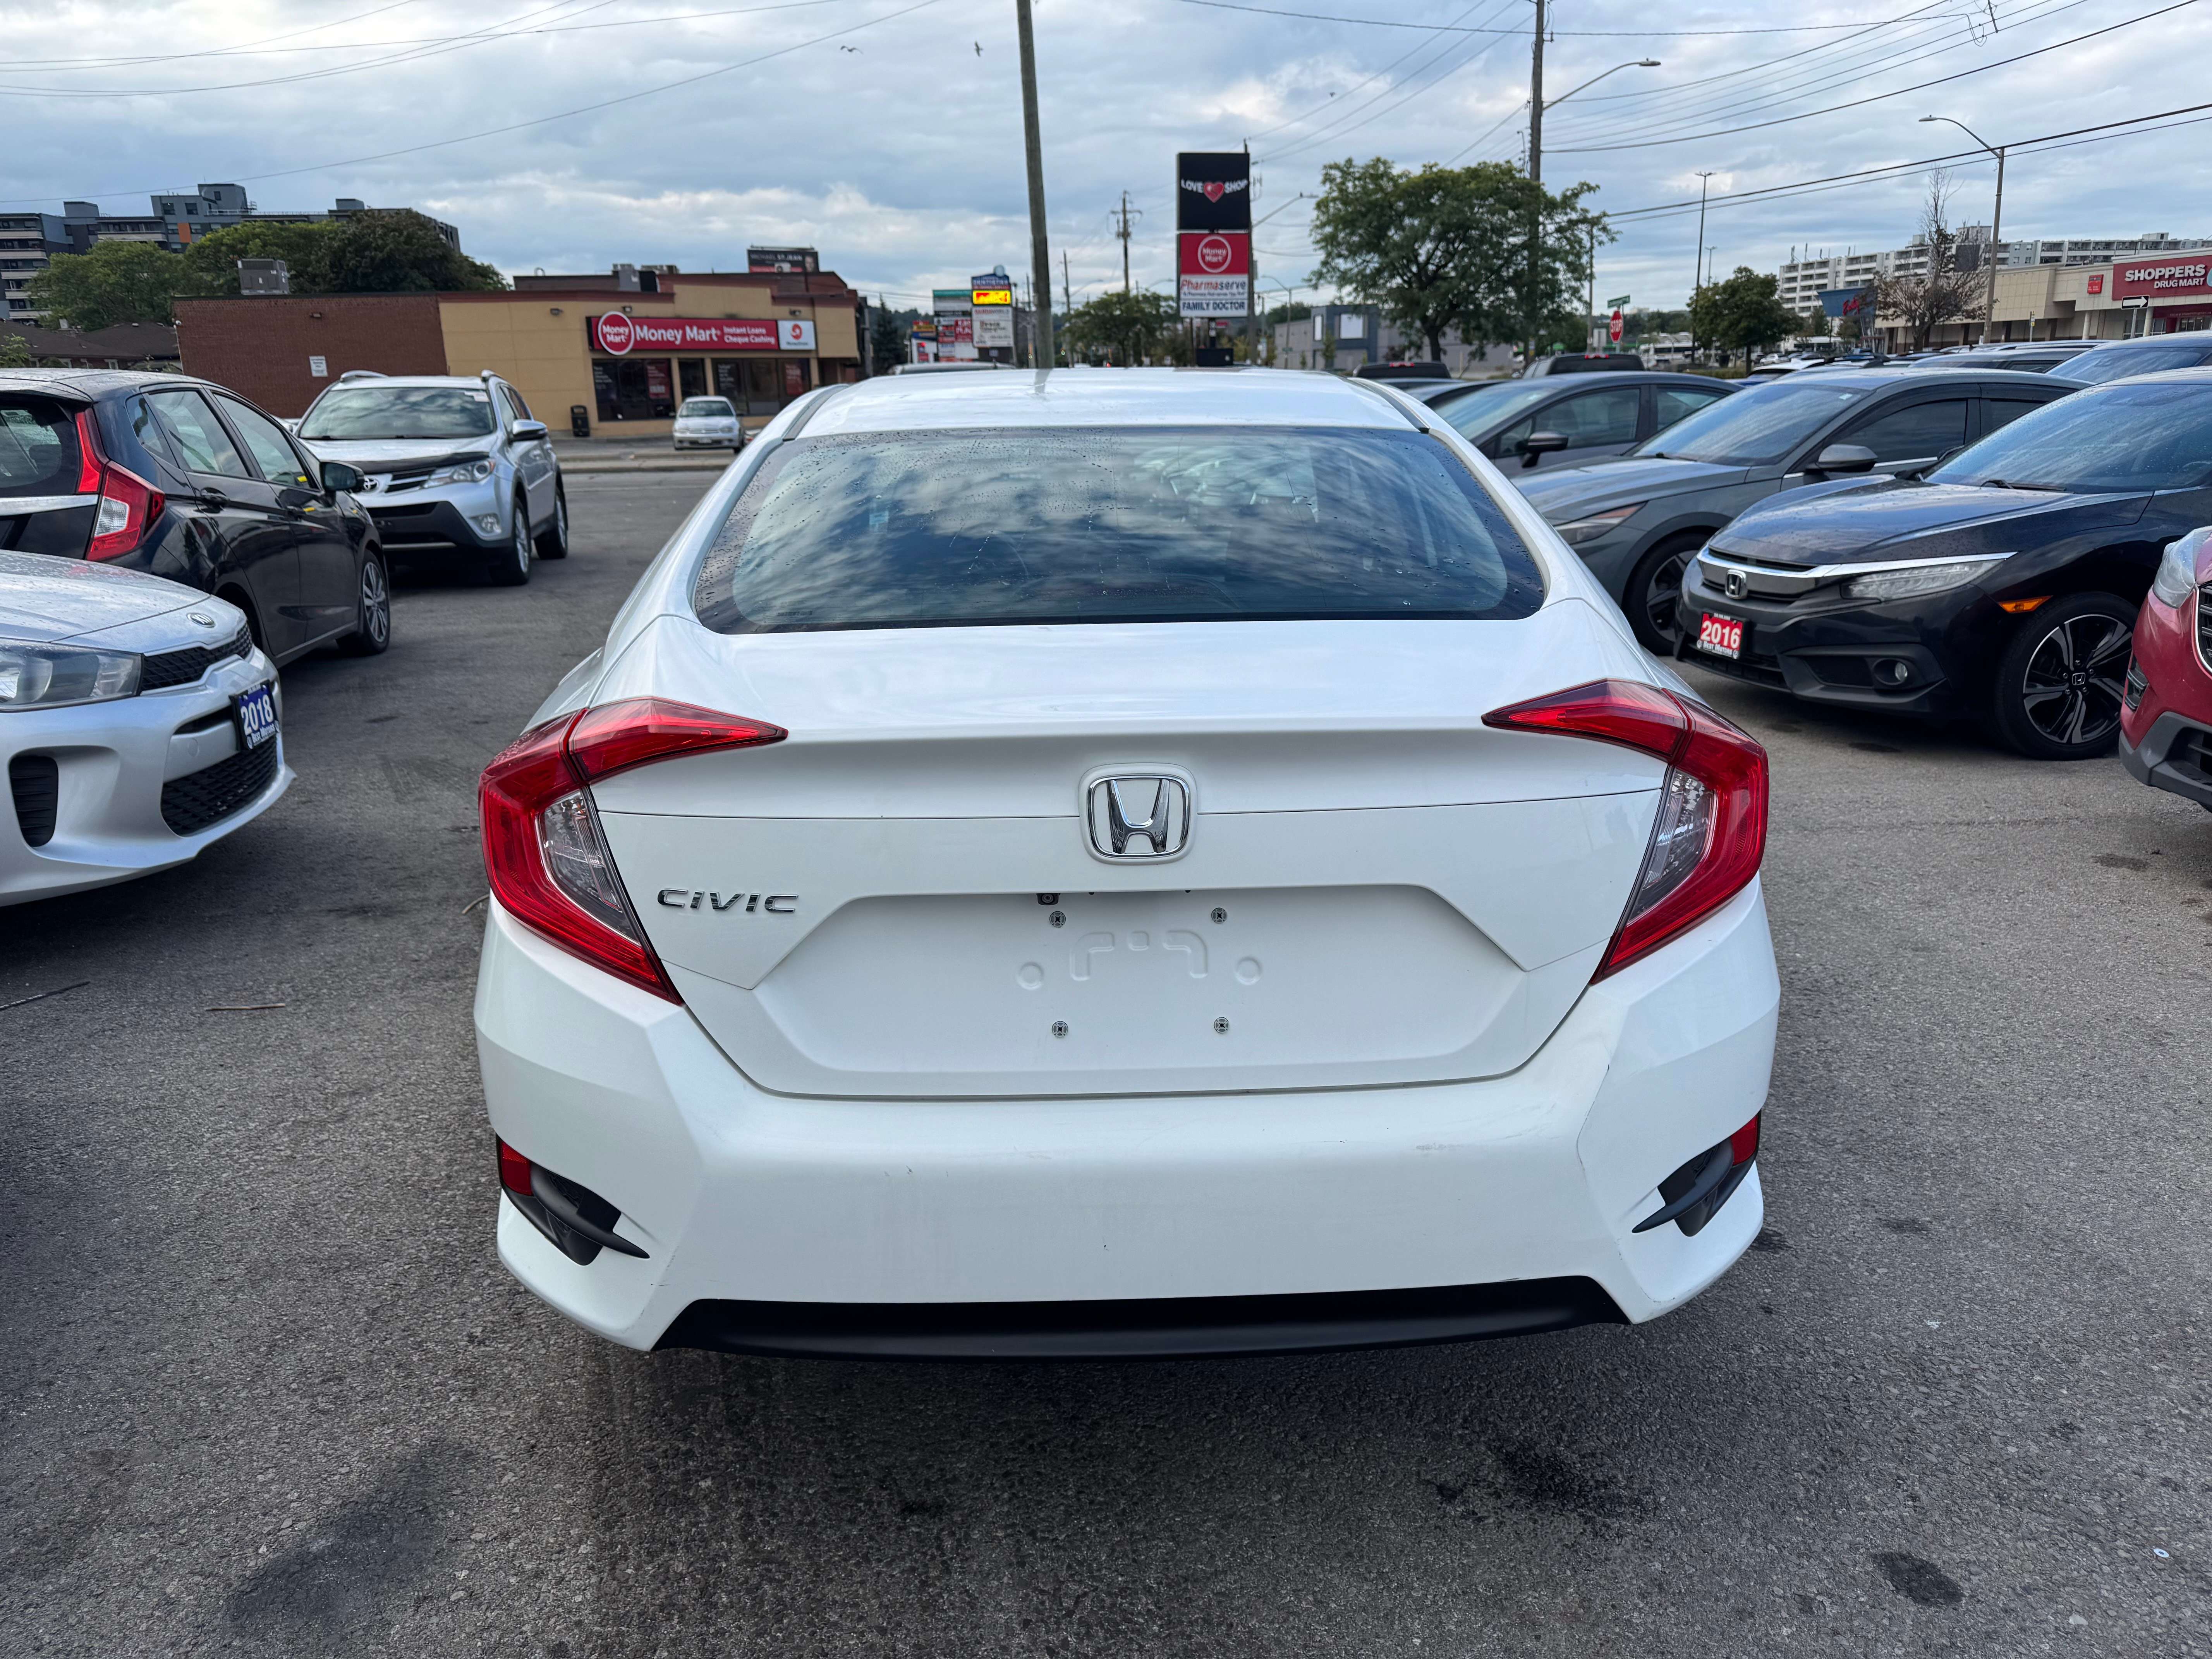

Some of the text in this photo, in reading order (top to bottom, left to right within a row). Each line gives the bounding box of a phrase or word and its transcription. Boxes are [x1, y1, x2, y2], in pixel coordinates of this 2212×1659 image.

[1181, 179, 1248, 194] LOVE SHOP
[1202, 247, 1227, 256] Money
[2124, 264, 2206, 282] SHOPPERS
[1181, 279, 1246, 291] Pharmaserve
[2154, 278, 2205, 289] DRUG MART
[1182, 301, 1245, 310] FAMILY DOCTOR
[603, 325, 629, 335] Money
[723, 326, 766, 335] Instant Loans
[1611, 319, 1623, 333] STOP
[606, 335, 626, 343] Mart
[635, 325, 718, 345] Money Mart
[724, 335, 775, 345] Cheque Cashing
[1700, 620, 1740, 649] 2016
[240, 694, 273, 736] 2018
[657, 888, 799, 914] CIVIC
